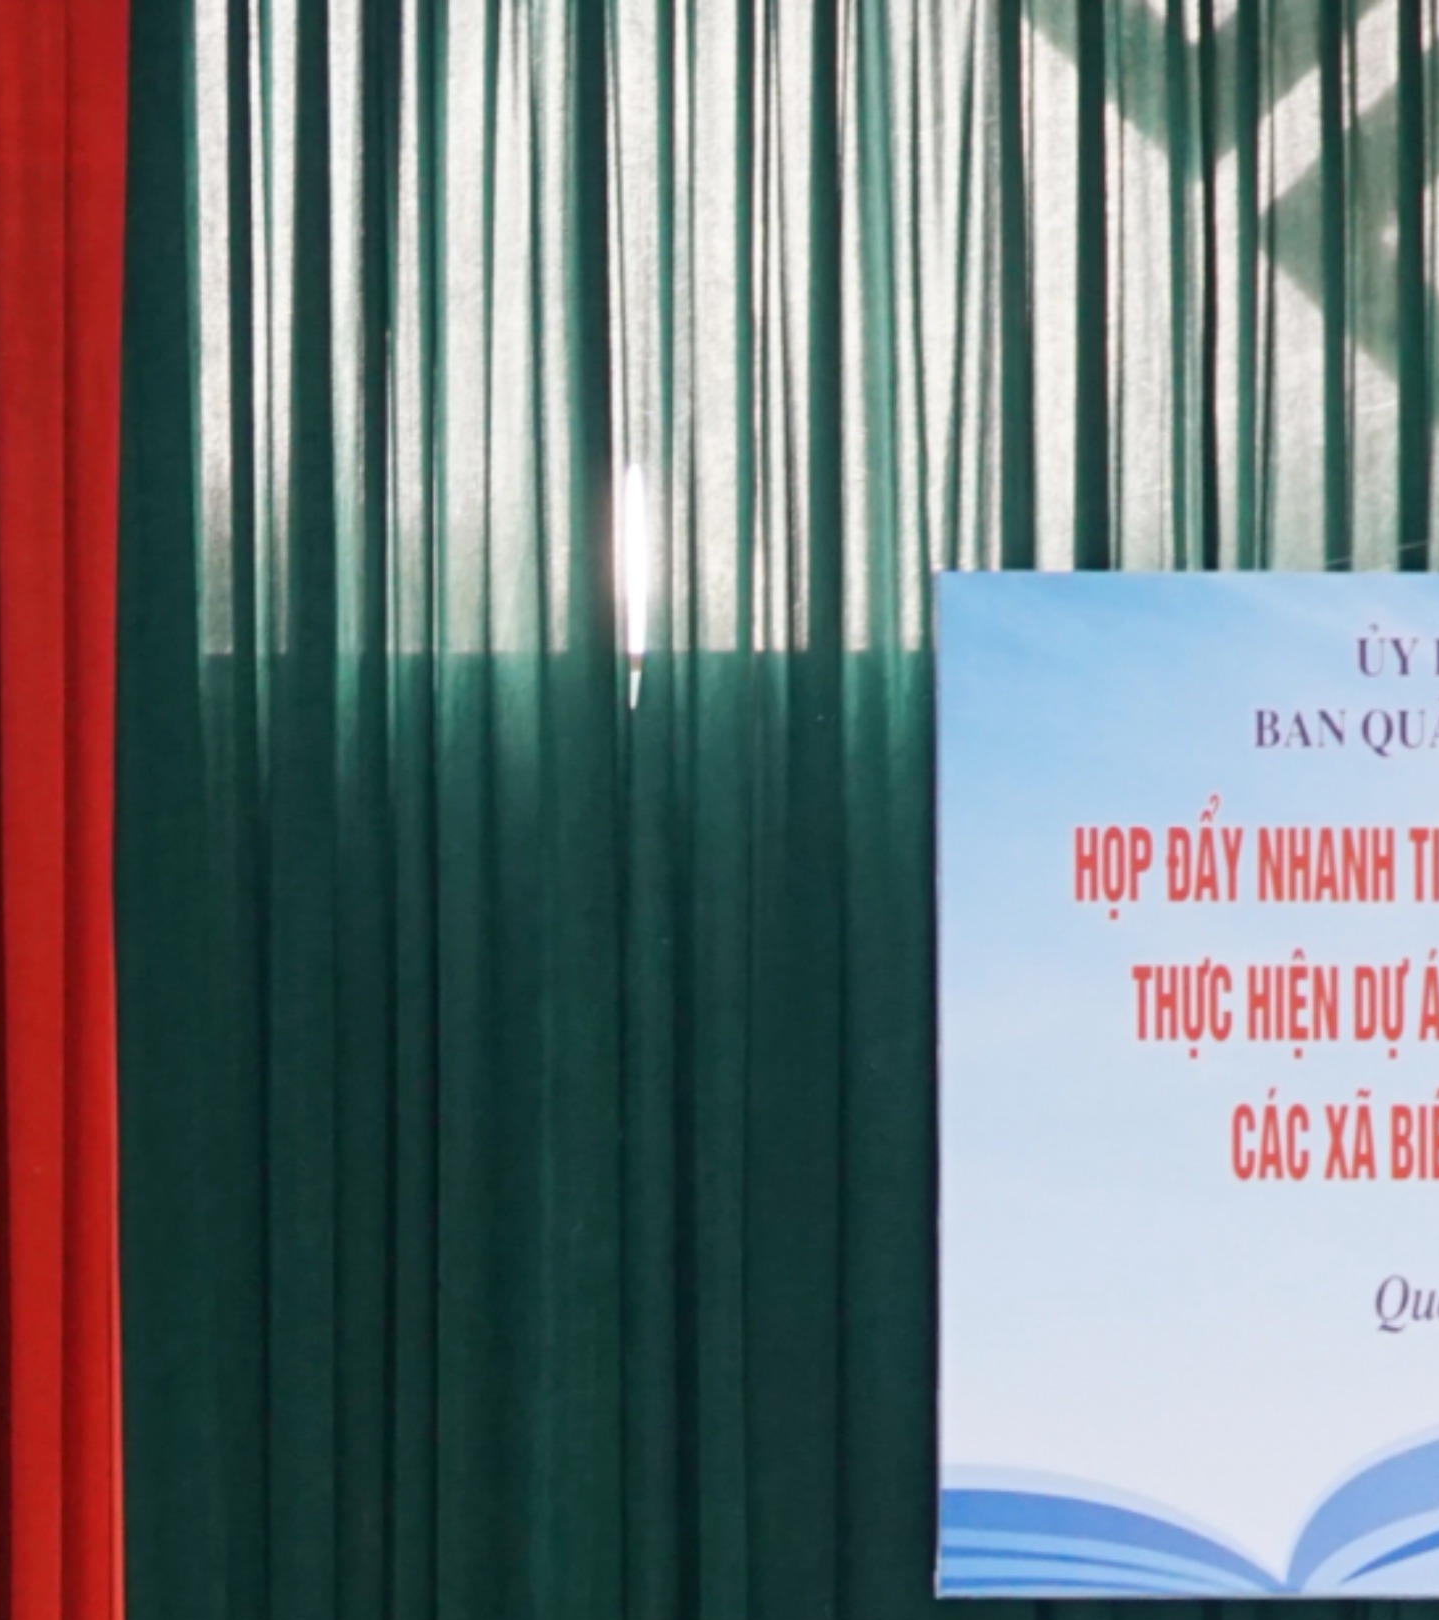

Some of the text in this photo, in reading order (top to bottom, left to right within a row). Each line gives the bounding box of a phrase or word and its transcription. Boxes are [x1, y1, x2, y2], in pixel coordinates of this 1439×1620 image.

[1357, 624, 1416, 677] ỦY
[1255, 709, 1345, 748] BAN
[1074, 825, 1154, 920] HỌP
[1165, 794, 1244, 903] ĐẨY
[1257, 826, 1395, 902] NHANH
[1131, 957, 1233, 1059] THỰC
[1247, 948, 1339, 1059] HIỆN
[1353, 958, 1410, 1060] DỰ
[1231, 1087, 1310, 1181] CÁC
[1324, 1088, 1377, 1180] XÃ
